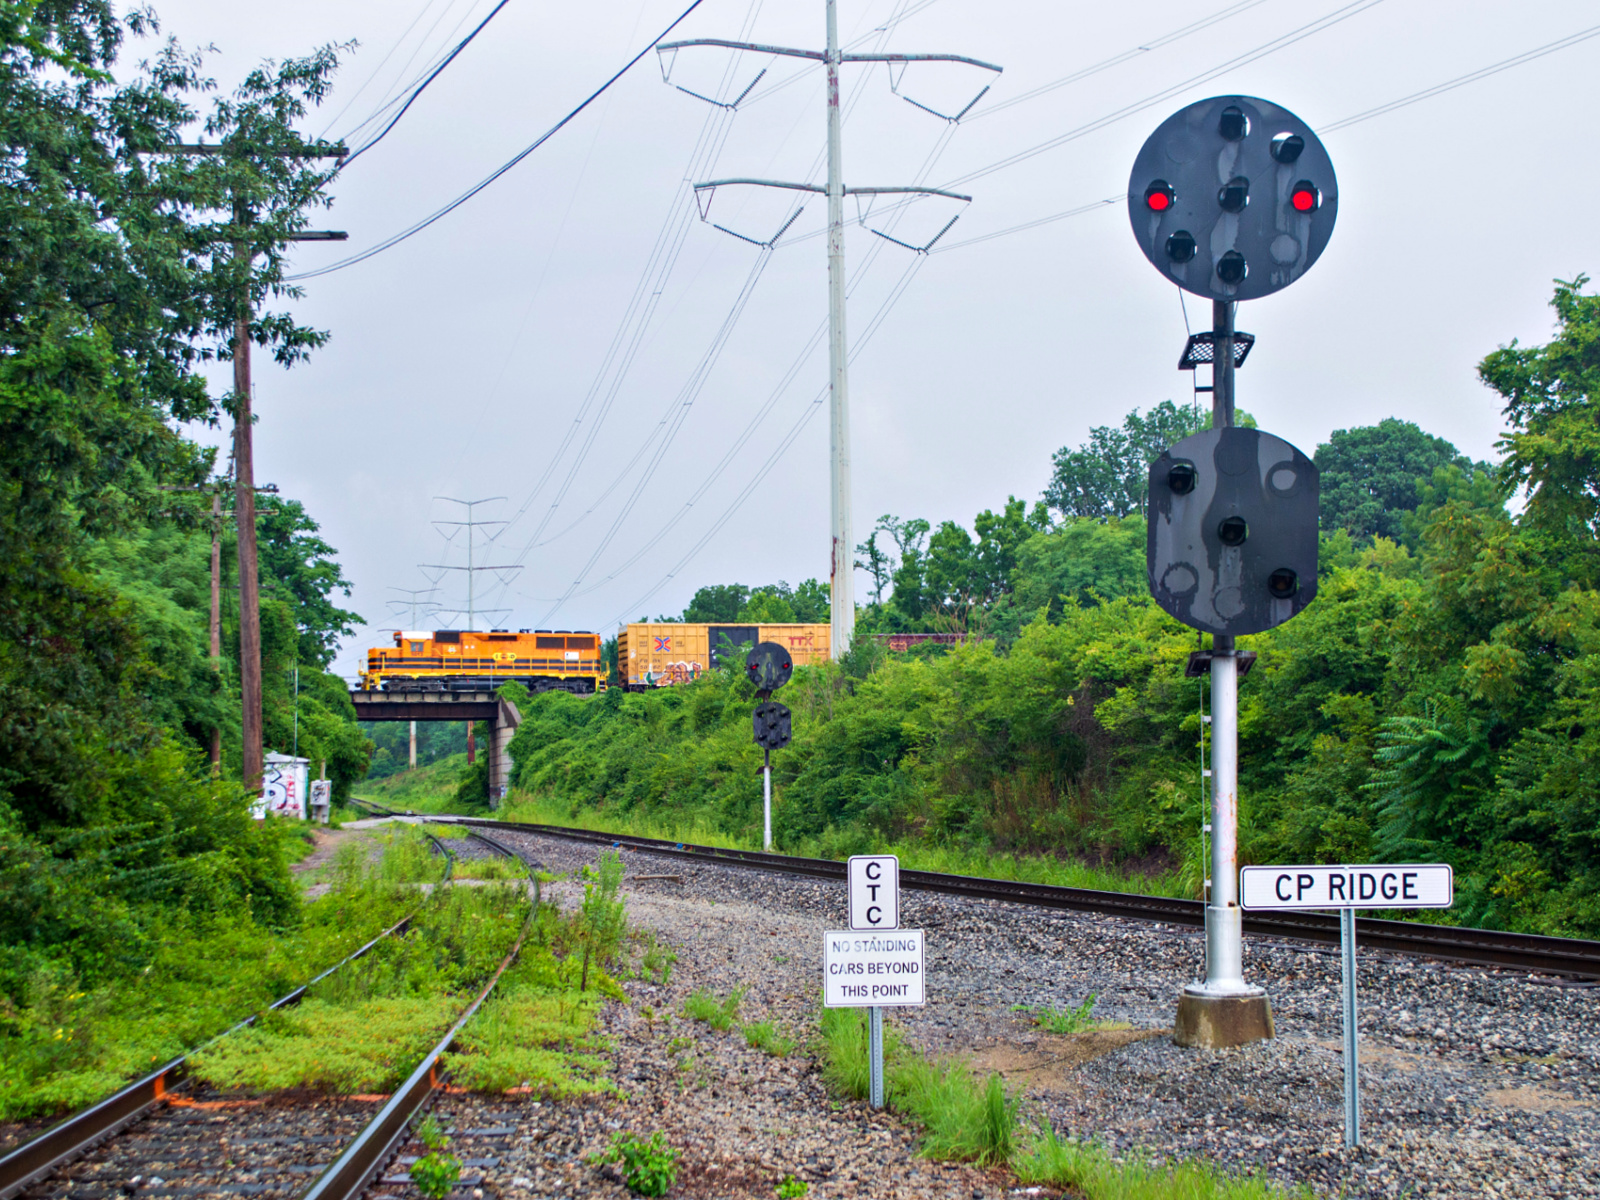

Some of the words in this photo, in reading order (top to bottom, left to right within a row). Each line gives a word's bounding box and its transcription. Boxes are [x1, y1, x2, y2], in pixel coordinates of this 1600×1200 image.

[788, 636, 813, 646] TTX
[865, 862, 882, 924] CTC
[1275, 874, 1315, 901] CP
[1328, 873, 1418, 900] RIDGE
[832, 941, 850, 952] NO
[854, 940, 916, 952] STANDING
[830, 963, 864, 975] CARS
[868, 962, 919, 974] BEYOND
[841, 985, 868, 997] THIS
[872, 984, 909, 997] POINT
